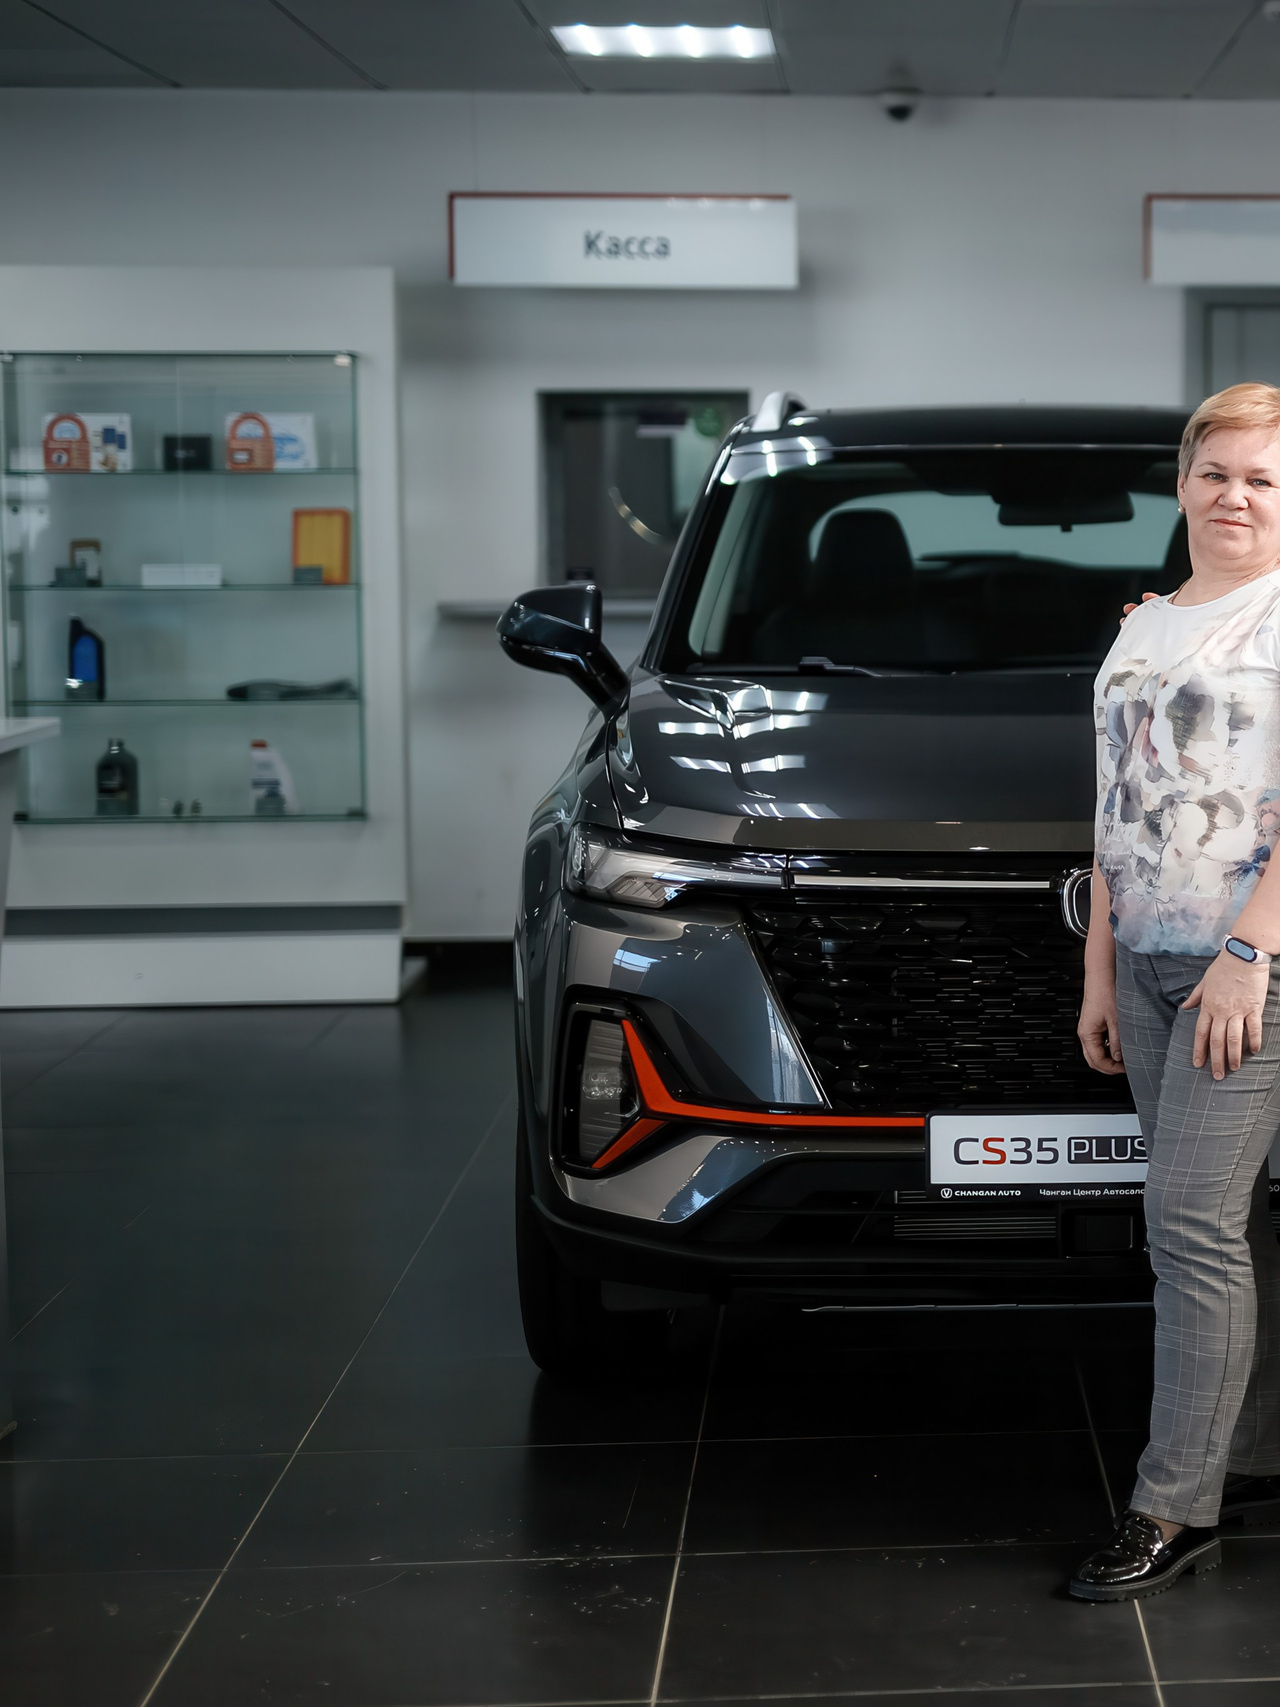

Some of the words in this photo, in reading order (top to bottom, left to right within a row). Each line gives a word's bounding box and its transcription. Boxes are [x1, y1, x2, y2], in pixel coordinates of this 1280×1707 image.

[583, 230, 672, 260] Касса
[953, 1137, 1060, 1165] CS35
[1070, 1138, 1148, 1161] PLUS
[954, 1189, 996, 1197] CHANGAN
[997, 1189, 1022, 1197] AUTO
[1039, 1188, 1072, 1196] Чанган
[1073, 1188, 1101, 1197] Центр
